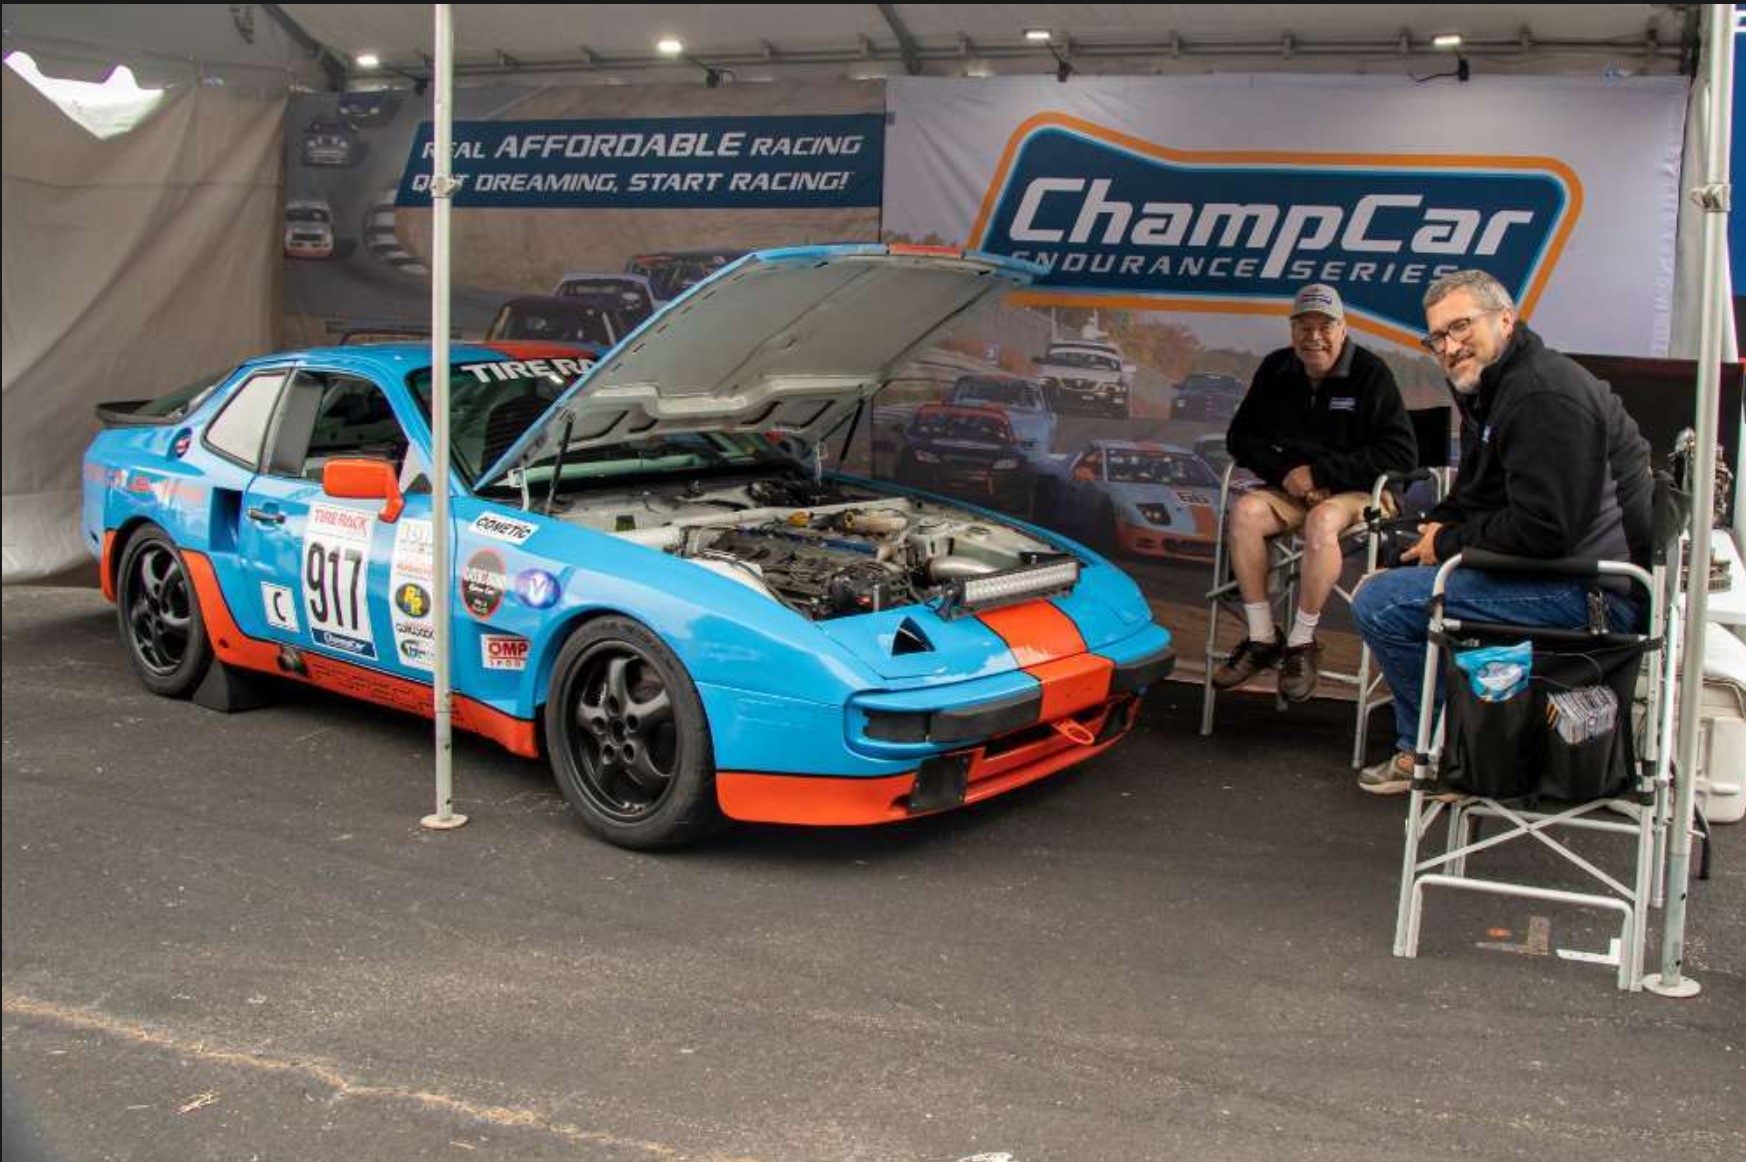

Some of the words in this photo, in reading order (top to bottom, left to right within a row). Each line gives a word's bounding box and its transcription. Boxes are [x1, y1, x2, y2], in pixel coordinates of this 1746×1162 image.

[493, 131, 746, 158] AFFORDABLE
[751, 135, 865, 156] RACING
[411, 173, 470, 192] QT
[474, 173, 618, 193] DREAMING,
[626, 172, 724, 192] START
[729, 171, 850, 191] RACING!
[1008, 176, 1535, 279] ChampCar
[1287, 260, 1459, 284] SERIES
[460, 359, 550, 384] TIRE
[305, 541, 363, 631] 917
[272, 591, 287, 622] C
[488, 641, 529, 656] OMP
